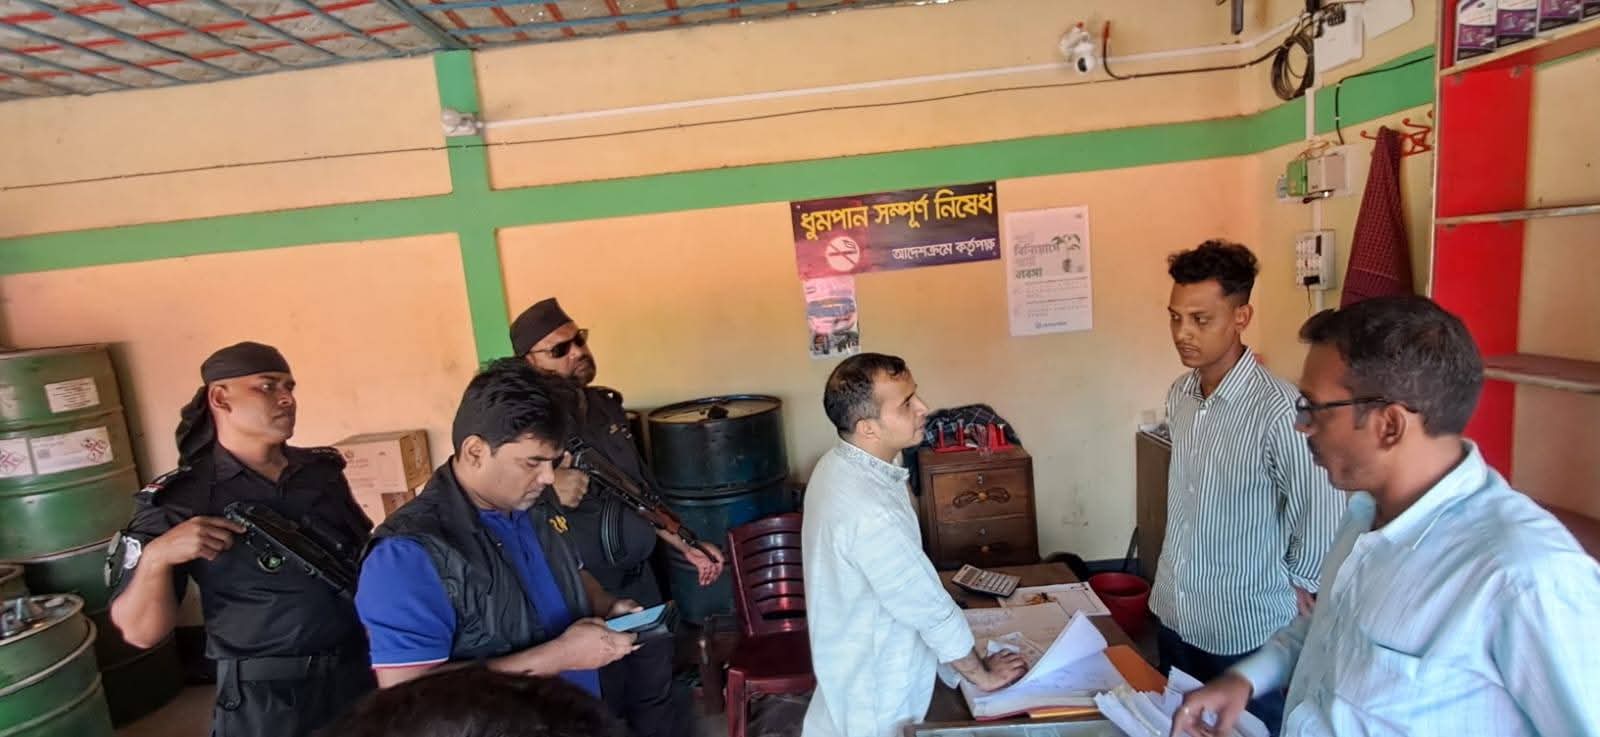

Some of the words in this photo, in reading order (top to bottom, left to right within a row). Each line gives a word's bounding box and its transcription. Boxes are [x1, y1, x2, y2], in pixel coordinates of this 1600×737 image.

[800, 205, 868, 240] ধুমপান
[873, 193, 929, 229] সম্পূর্ণ
[934, 188, 994, 220] নিষেধ
[892, 243, 953, 260] আদেশক্রমে
[955, 237, 996, 256] কর্তৃপক্ষ
